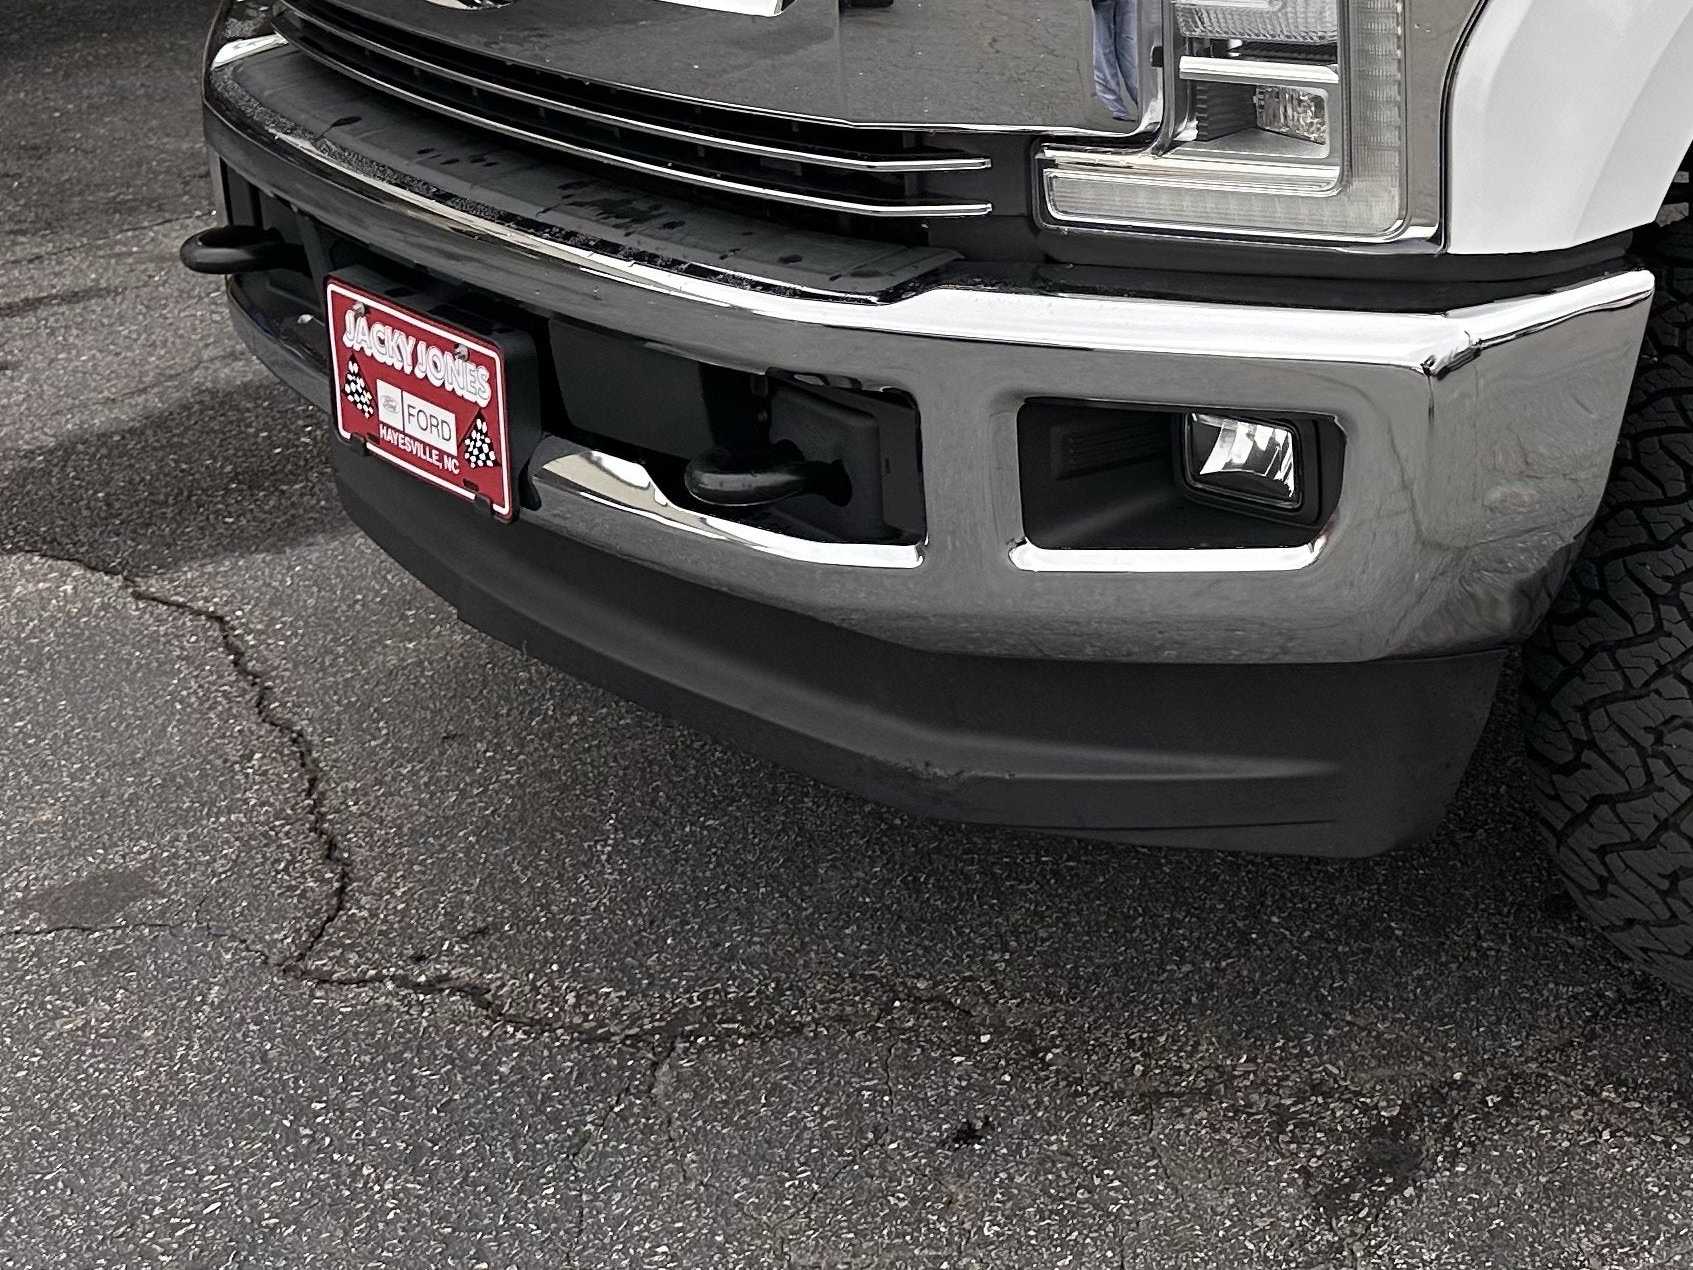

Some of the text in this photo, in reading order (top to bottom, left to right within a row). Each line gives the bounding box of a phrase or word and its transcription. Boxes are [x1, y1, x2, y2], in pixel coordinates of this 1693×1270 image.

[343, 310, 492, 408] JACKY JONES
[379, 423, 460, 475] HAYESVILLE, NC
[407, 404, 452, 442] FORD
